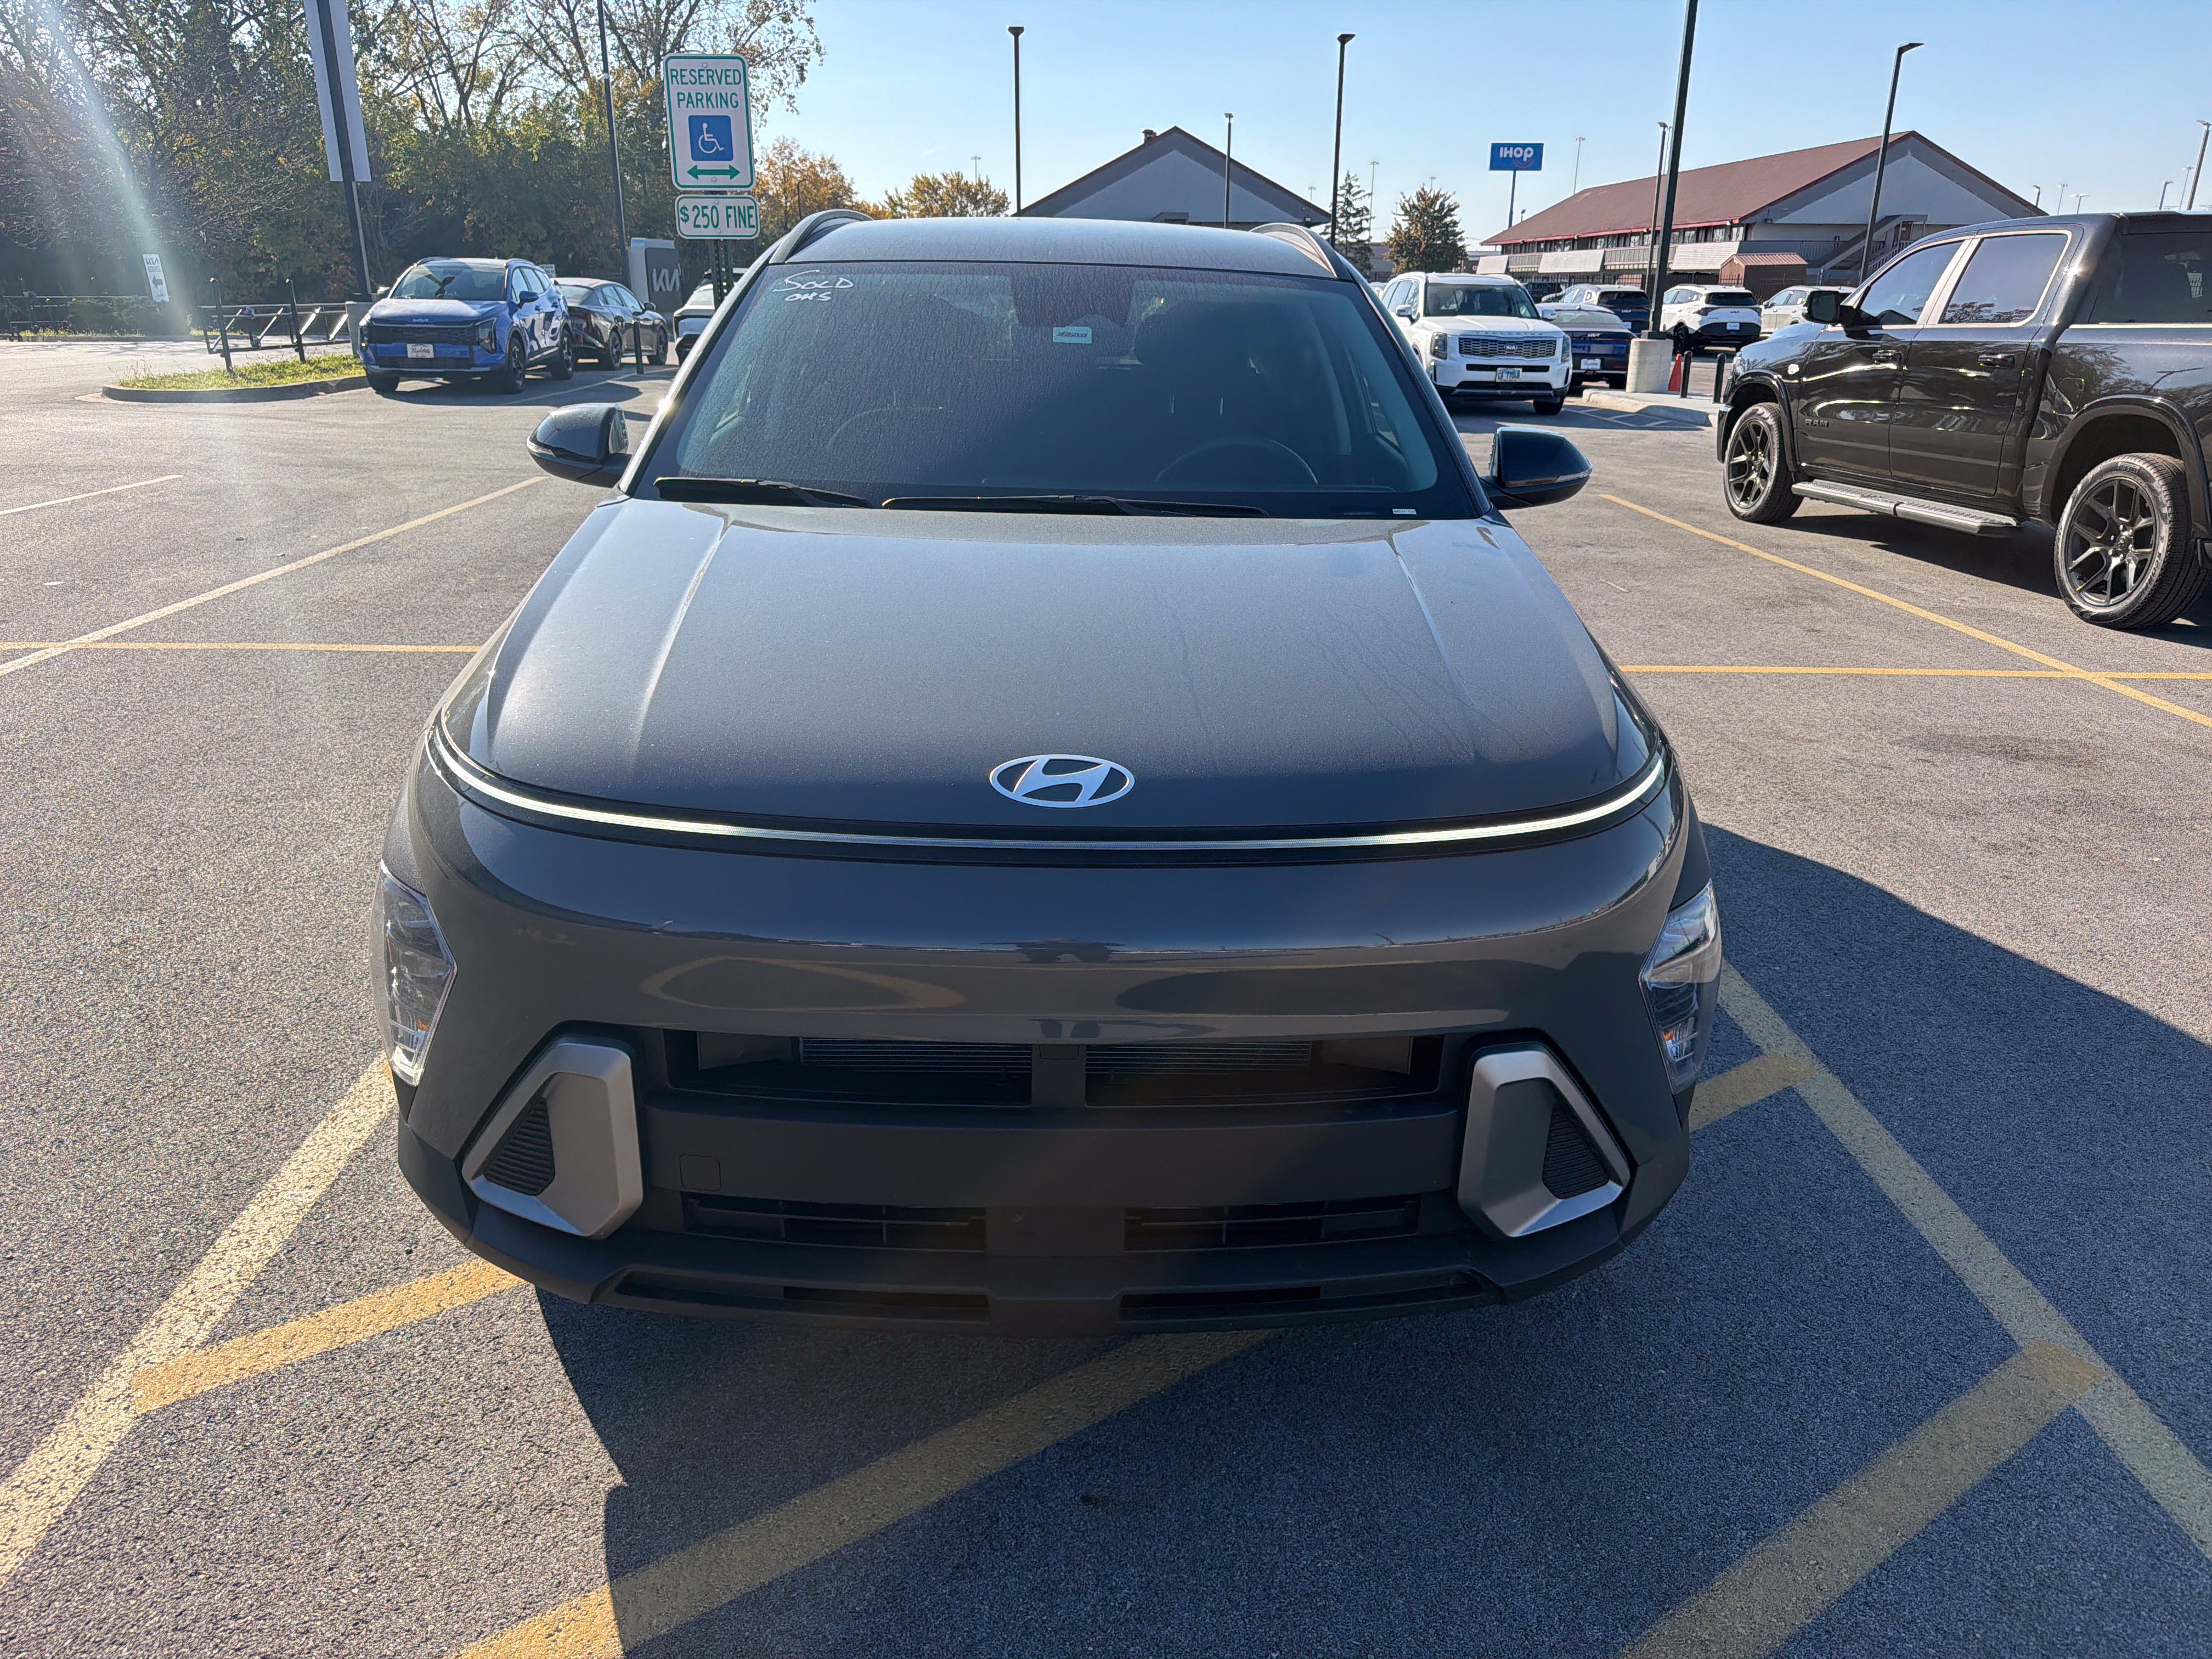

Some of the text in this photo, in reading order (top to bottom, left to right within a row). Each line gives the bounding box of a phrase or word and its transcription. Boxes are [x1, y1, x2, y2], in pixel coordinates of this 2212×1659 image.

[670, 68, 741, 85] RESERVED
[676, 92, 739, 109] PARKING
[725, 205, 755, 229] FINE
[652, 268, 680, 292] KIA
[1805, 419, 1829, 427] RAM
